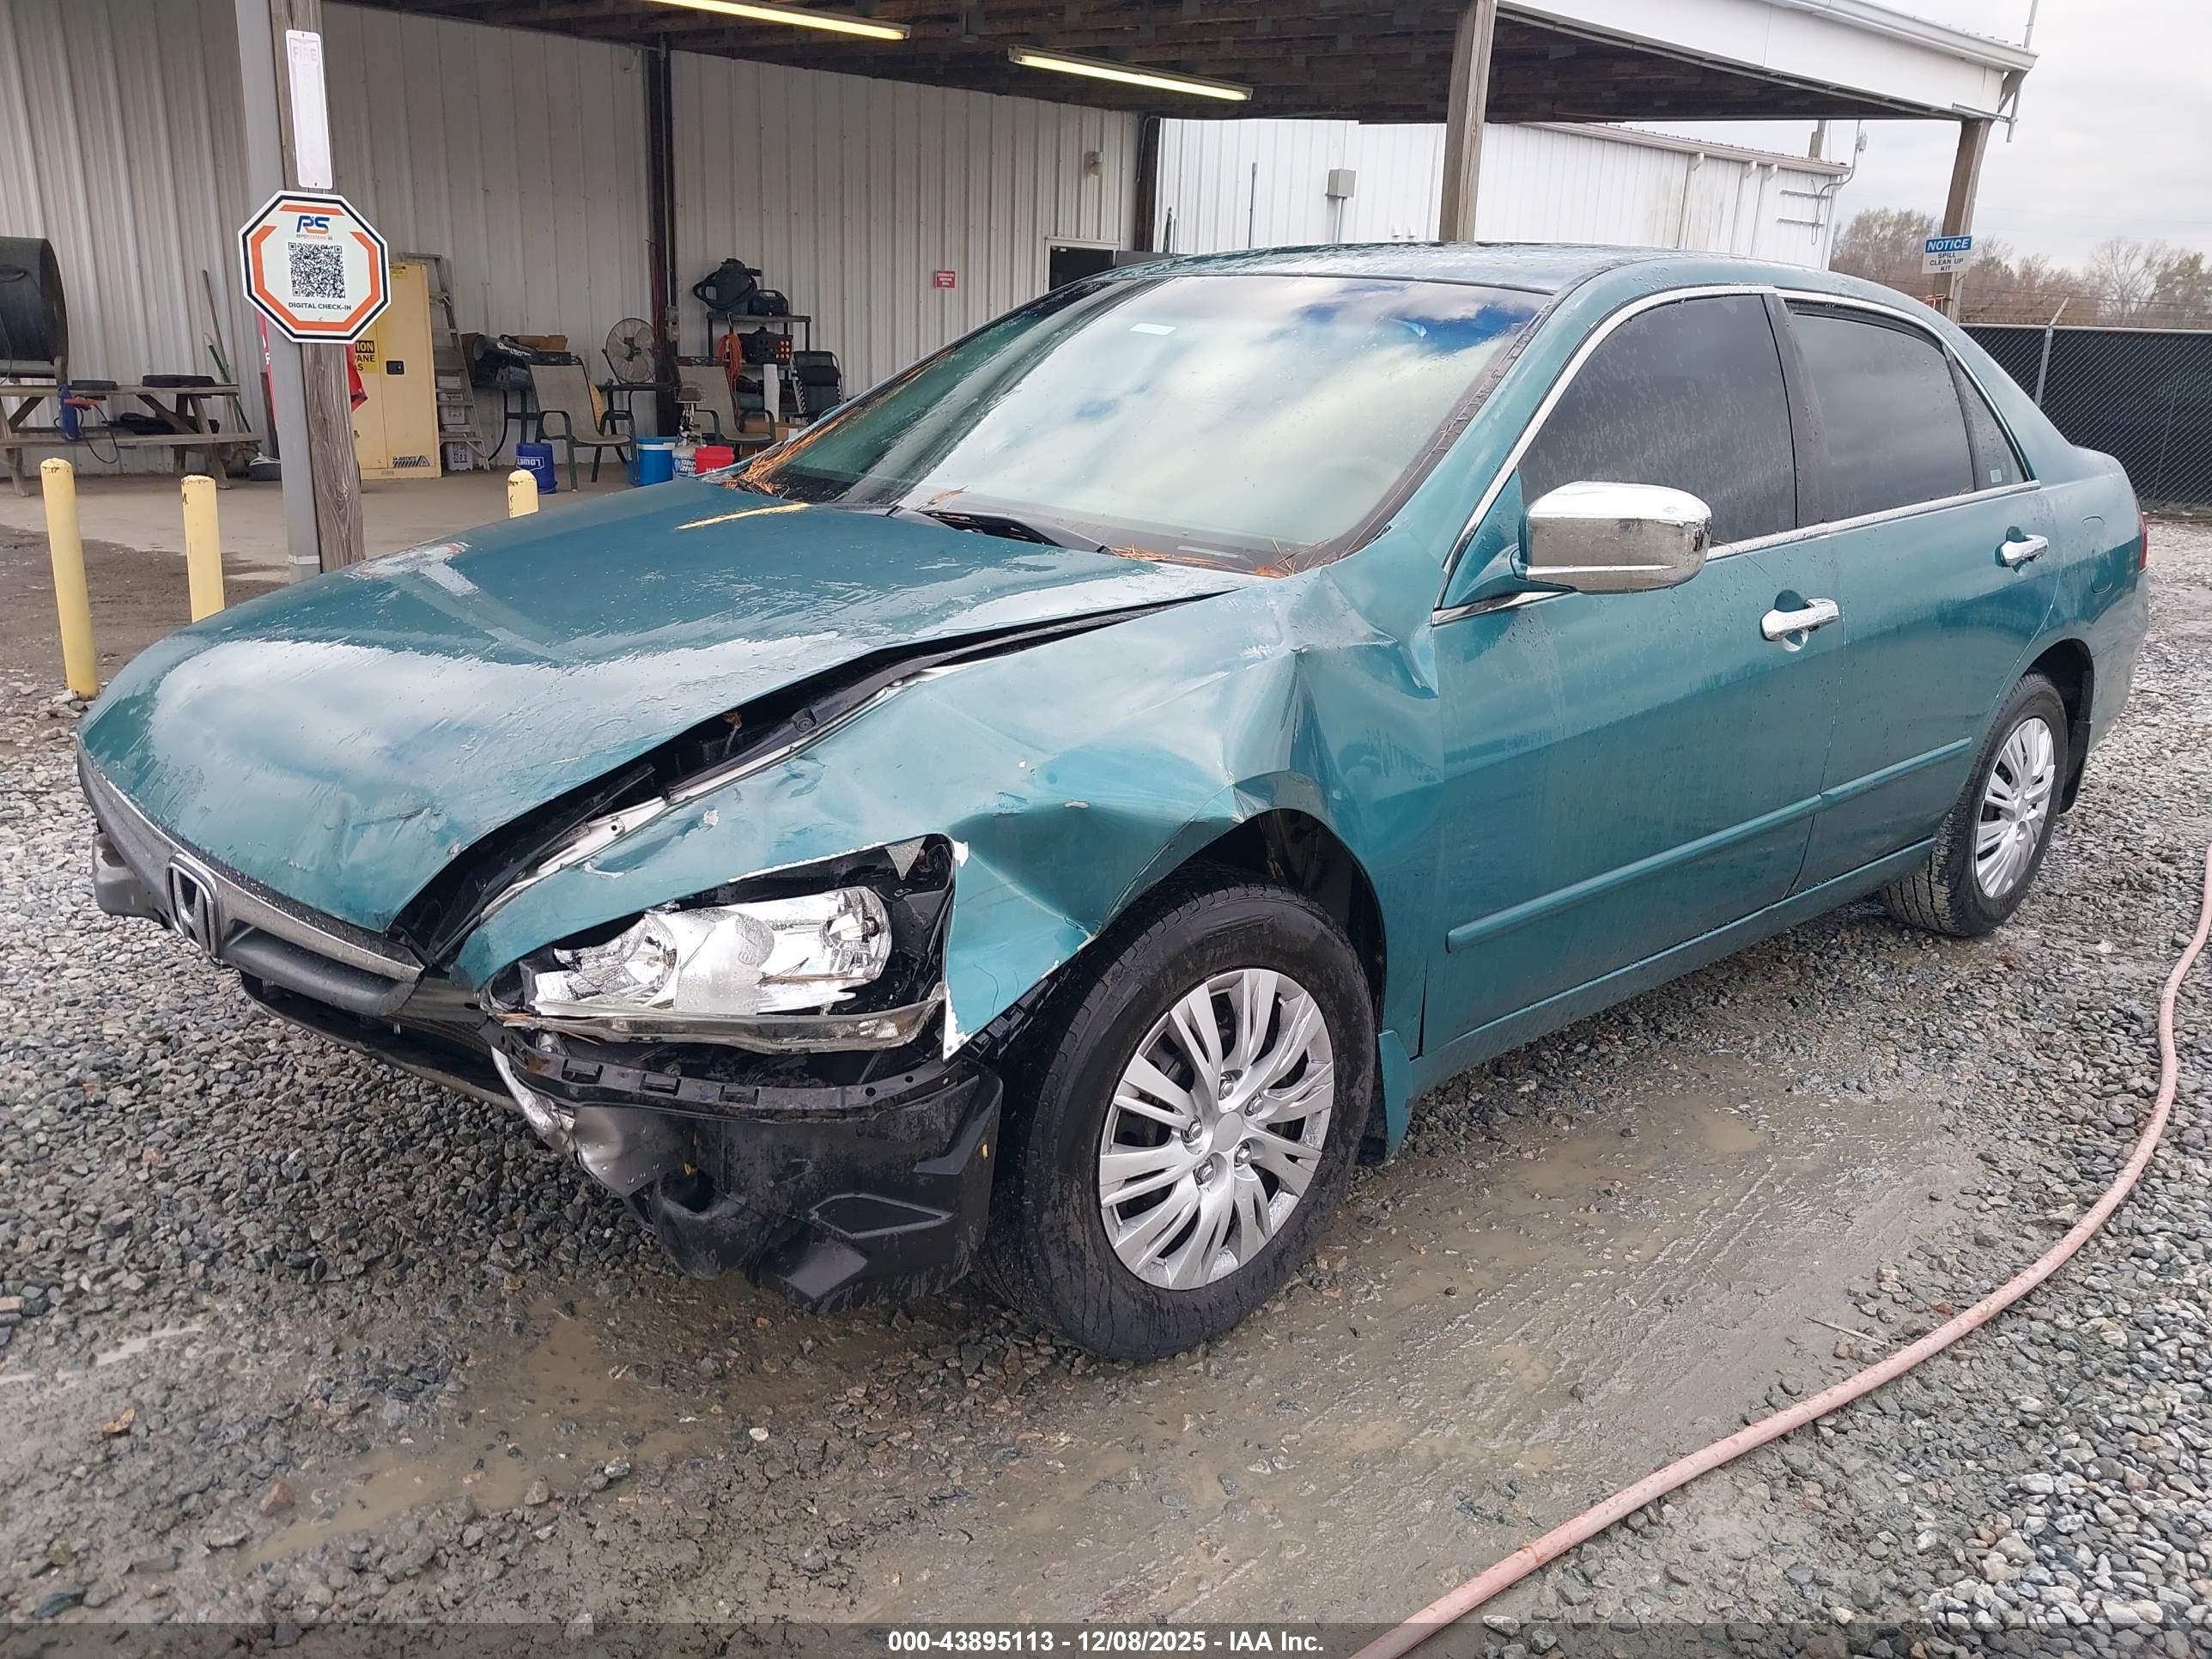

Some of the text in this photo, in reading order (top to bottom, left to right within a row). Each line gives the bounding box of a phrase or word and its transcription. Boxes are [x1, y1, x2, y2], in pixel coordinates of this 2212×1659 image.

[1927, 239, 1971, 252] NOTICE
[288, 301, 352, 311] DIGITAL CHECK-IN
